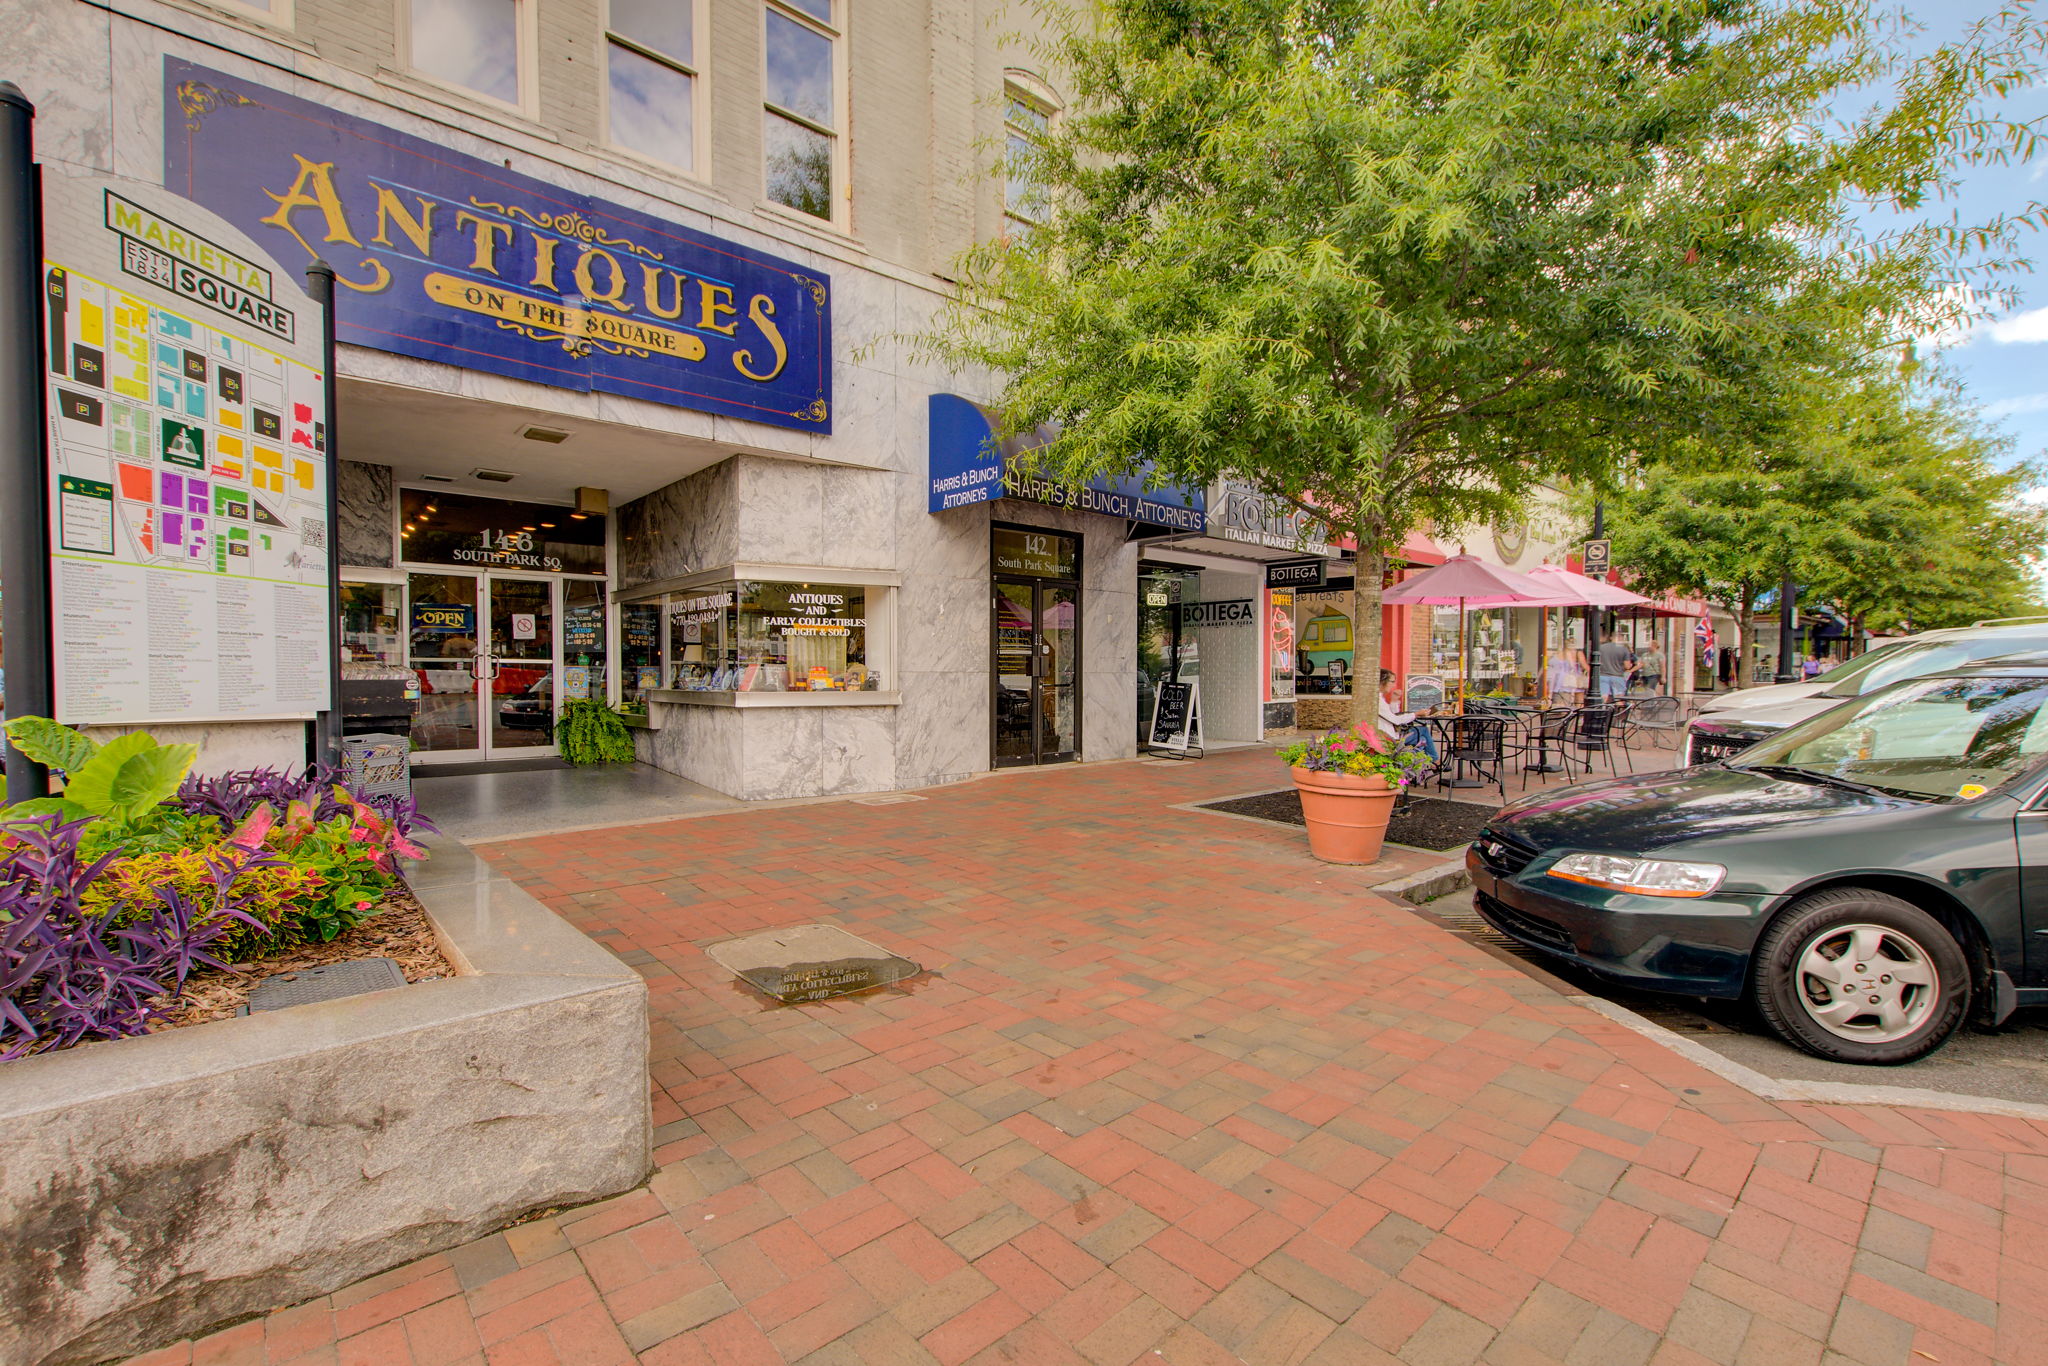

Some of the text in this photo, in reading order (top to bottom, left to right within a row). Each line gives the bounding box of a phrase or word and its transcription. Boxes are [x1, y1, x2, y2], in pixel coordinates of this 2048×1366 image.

[115, 202, 265, 295] MARIETTA
[127, 256, 170, 286] 1834
[259, 152, 788, 383] ANTIQUES
[181, 268, 288, 334] SQUARE
[464, 286, 678, 353] ON THE SQUARE
[933, 465, 999, 494] HARRIS & BUNCH
[942, 487, 988, 509] ATTORNEYS
[1008, 471, 1064, 504] HARRIS
[1082, 487, 1132, 518] BUNCH,
[1135, 498, 1202, 530] ATTORNEYS
[1226, 493, 1328, 542] BOTTEGA
[479, 527, 534, 552] 146
[1023, 534, 1049, 556] 142
[1224, 527, 1260, 545] ITALIAN
[1262, 534, 1296, 552] MARKET
[1306, 542, 1329, 556] PIZZA
[453, 549, 501, 564] SOUTH
[505, 553, 541, 567] PARK
[997, 556, 1071, 575] South Park Square
[1270, 566, 1318, 581] BOTTEGA
[687, 598, 696, 612] ON
[696, 596, 708, 611] THE
[708, 592, 733, 610] SQUARE
[788, 593, 844, 606] ANTIQUES
[1149, 594, 1166, 605] OPEN
[1271, 593, 1293, 606] COFFEE
[415, 611, 465, 627] OPEN
[805, 605, 827, 615] AND
[1183, 602, 1253, 622] BOTTEGA
[762, 616, 867, 627] EARLY COLLECTIBLES
[781, 627, 851, 637] BOUGHT & SOLD
[1161, 688, 1184, 701] COLD
[1169, 701, 1184, 710] BEER
